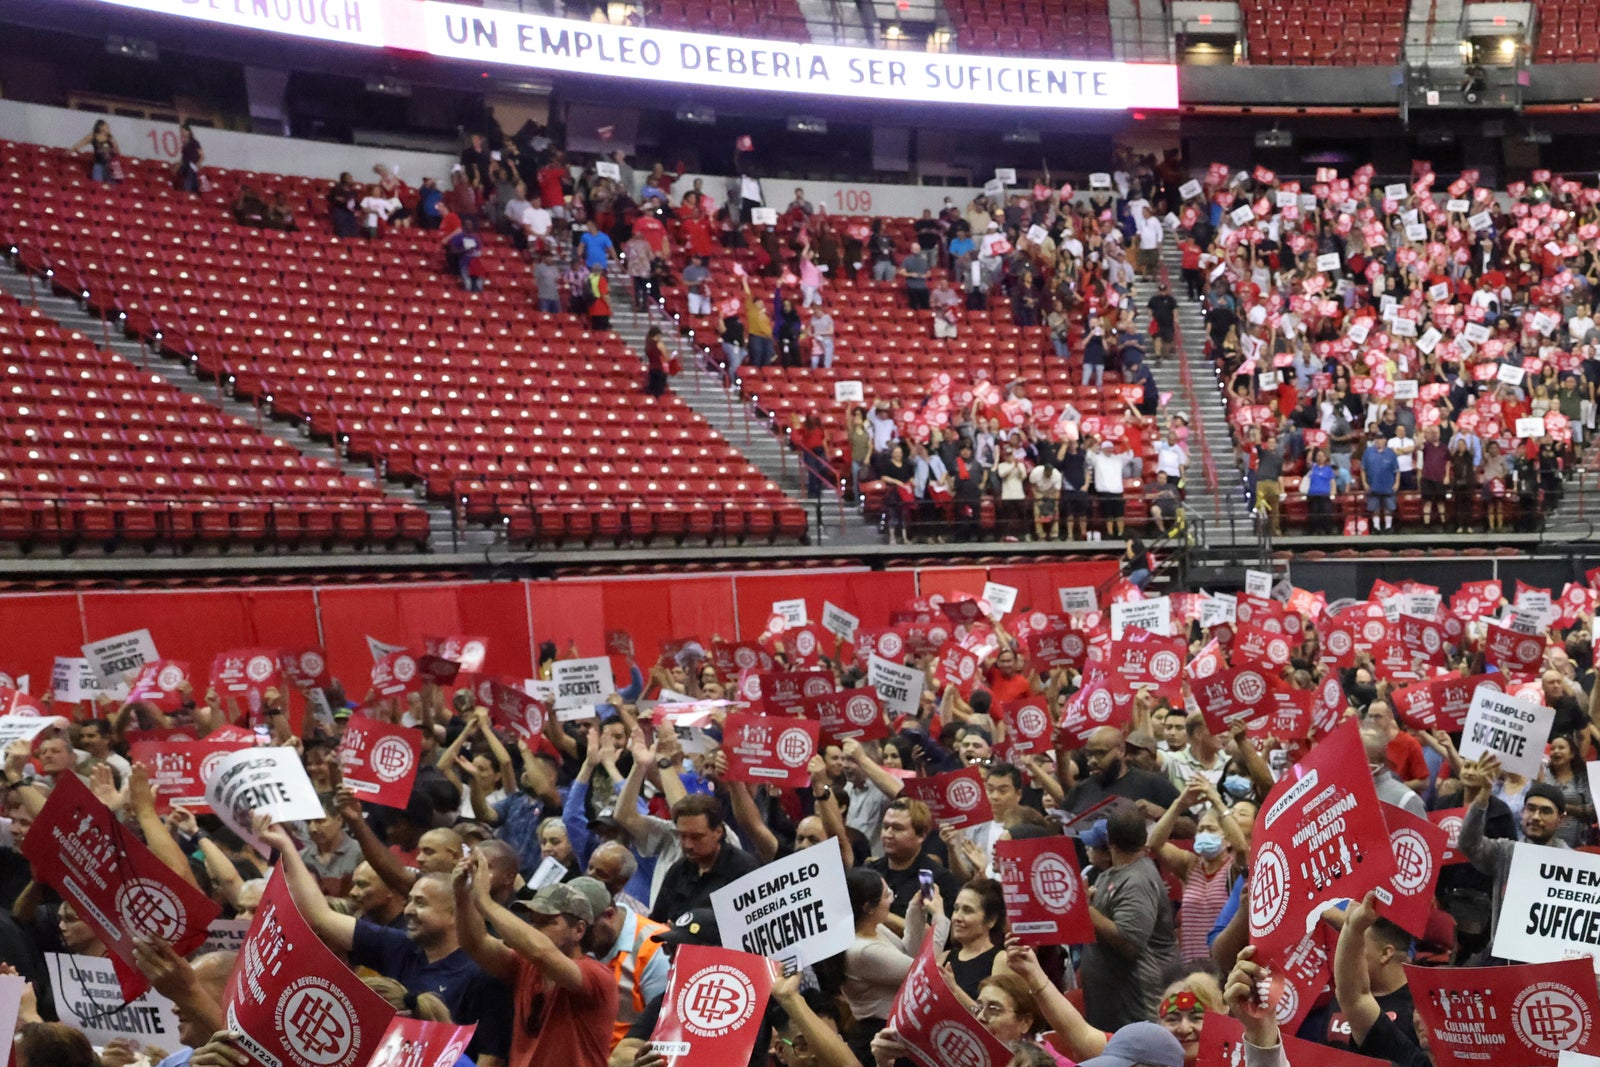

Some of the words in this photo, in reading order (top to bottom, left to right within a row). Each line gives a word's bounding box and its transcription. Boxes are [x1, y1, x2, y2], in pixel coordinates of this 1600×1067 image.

[446, 15, 497, 48] UN
[518, 24, 661, 67] EMPLEO
[849, 58, 907, 87] SER
[926, 63, 1109, 97] SUFICIENTE
[835, 190, 871, 212] 109
[1481, 698, 1493, 710] UN
[1494, 703, 1535, 723] EMPLEO
[1472, 722, 1527, 758] SUFICIENTE
[1317, 792, 1358, 829] WORKERS
[1292, 820, 1318, 848] UNION
[1308, 817, 1346, 853] CULINARY
[1538, 862, 1571, 882] UN
[732, 891, 758, 913] UN
[758, 863, 820, 904] EMPLEO
[788, 886, 812, 906] SER
[742, 900, 828, 960] SUFICIENTE
[75, 1001, 165, 1034] SUFICIENTE
[1444, 1019, 1485, 1033] CULINARY
[1434, 1028, 1472, 1044] WORKERS
[1475, 1032, 1506, 1045] UNION
